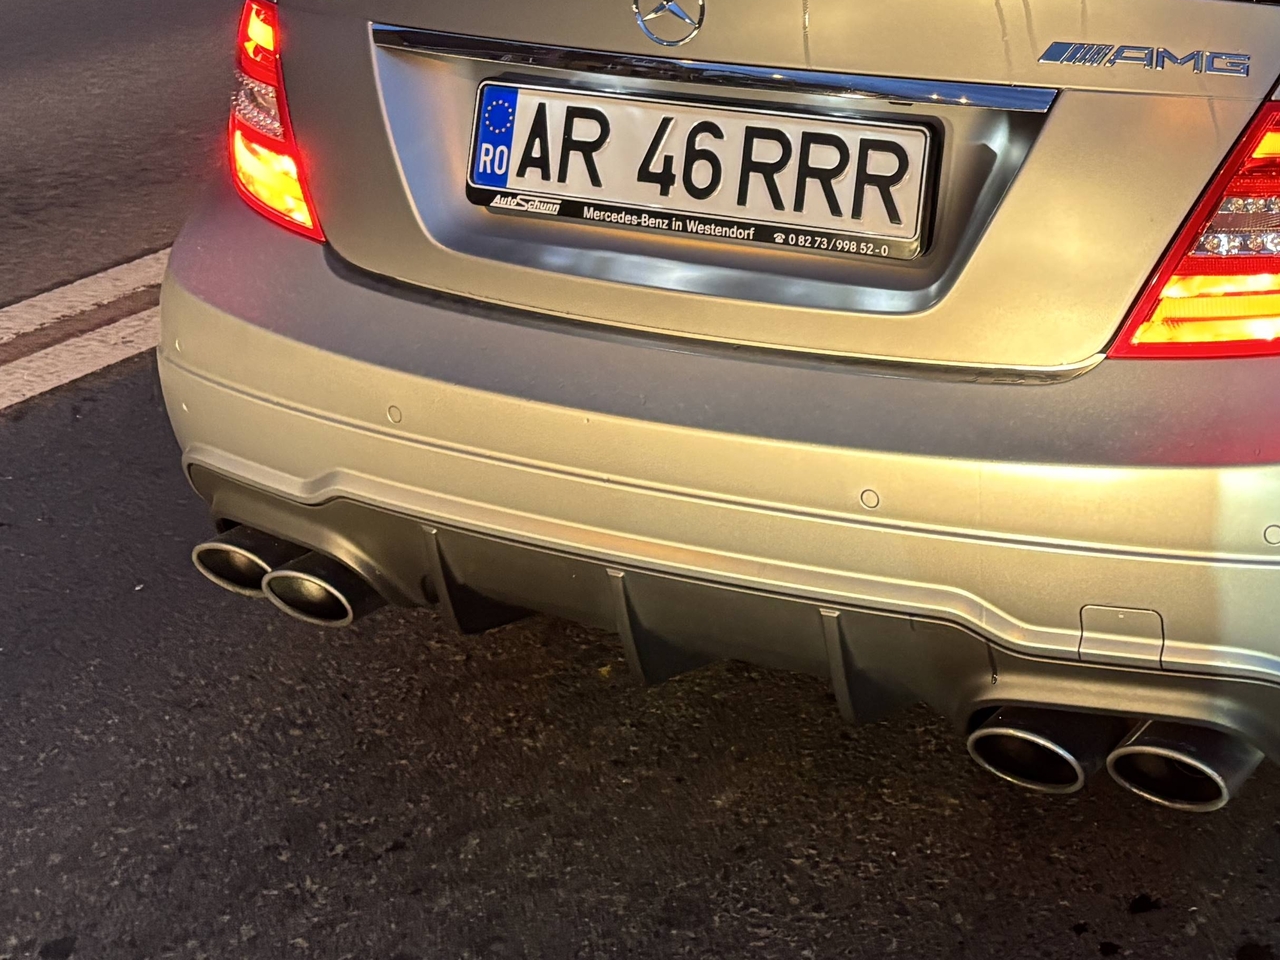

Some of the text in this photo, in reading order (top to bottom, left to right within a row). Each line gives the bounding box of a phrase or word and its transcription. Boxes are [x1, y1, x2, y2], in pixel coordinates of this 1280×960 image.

[1104, 45, 1251, 77] AMG
[479, 142, 509, 175] RO
[516, 101, 910, 226] AR 46 RRR
[583, 206, 756, 240] Mercedes-Benz in Westendorf
